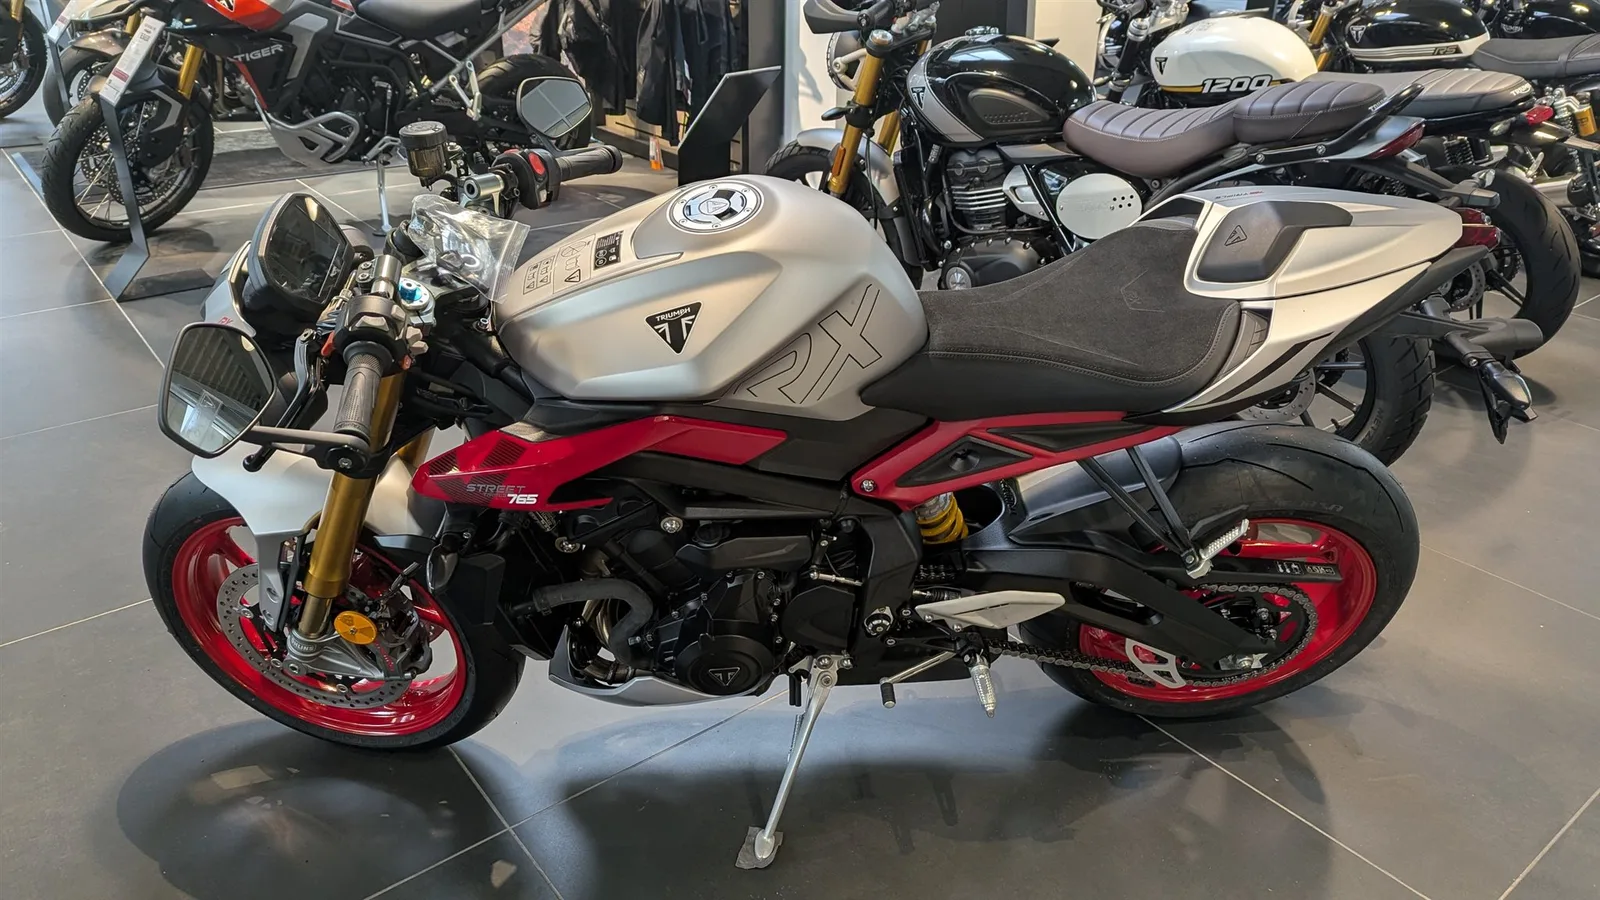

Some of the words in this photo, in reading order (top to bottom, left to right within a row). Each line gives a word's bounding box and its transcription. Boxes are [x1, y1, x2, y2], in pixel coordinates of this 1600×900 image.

[233, 44, 284, 62] TIGER
[1434, 45, 1458, 56] RS
[1202, 74, 1272, 94] 1200
[655, 307, 691, 321] TRIUMPH
[720, 283, 882, 405] RX
[466, 483, 526, 494] STREET
[507, 493, 539, 505] 765
